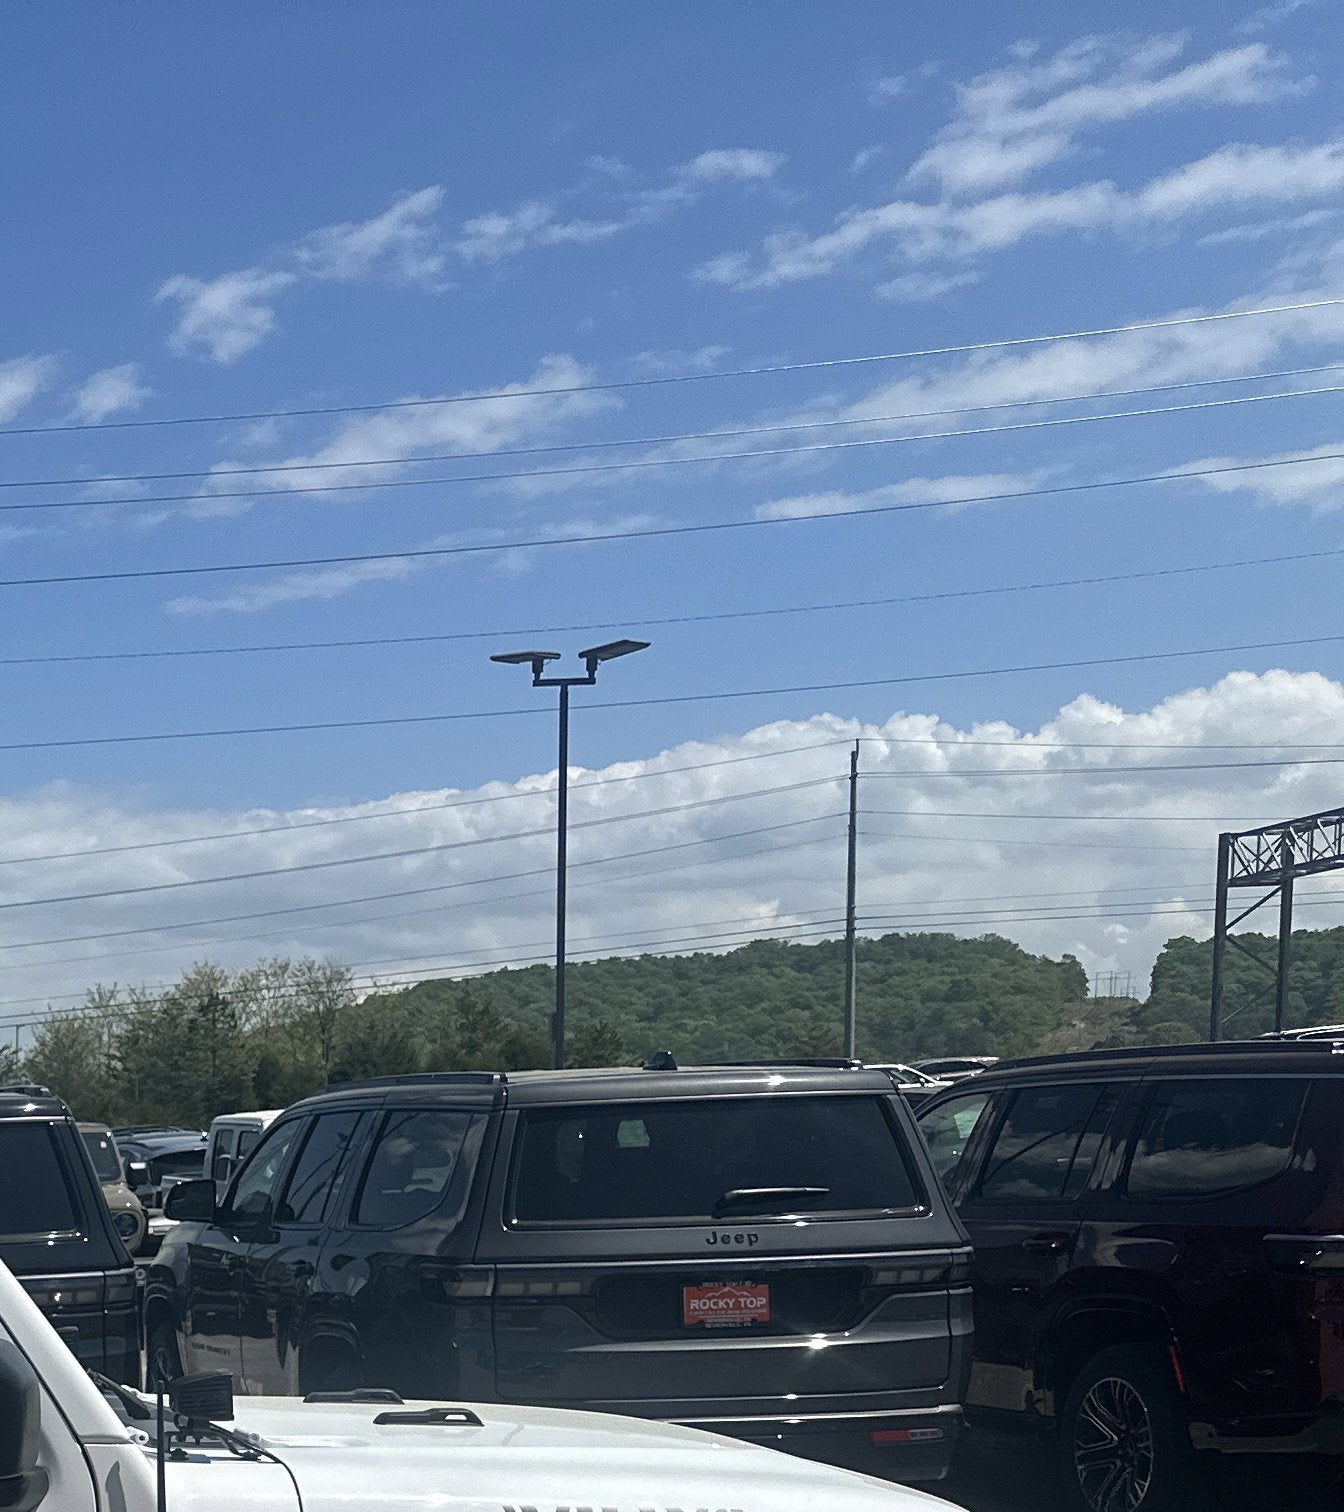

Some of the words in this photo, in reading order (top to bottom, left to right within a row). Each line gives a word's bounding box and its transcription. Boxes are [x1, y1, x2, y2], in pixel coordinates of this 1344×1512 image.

[705, 1231, 759, 1246] Jeep
[690, 1298, 735, 1310] ROCKY
[738, 1297, 767, 1309] TOP
